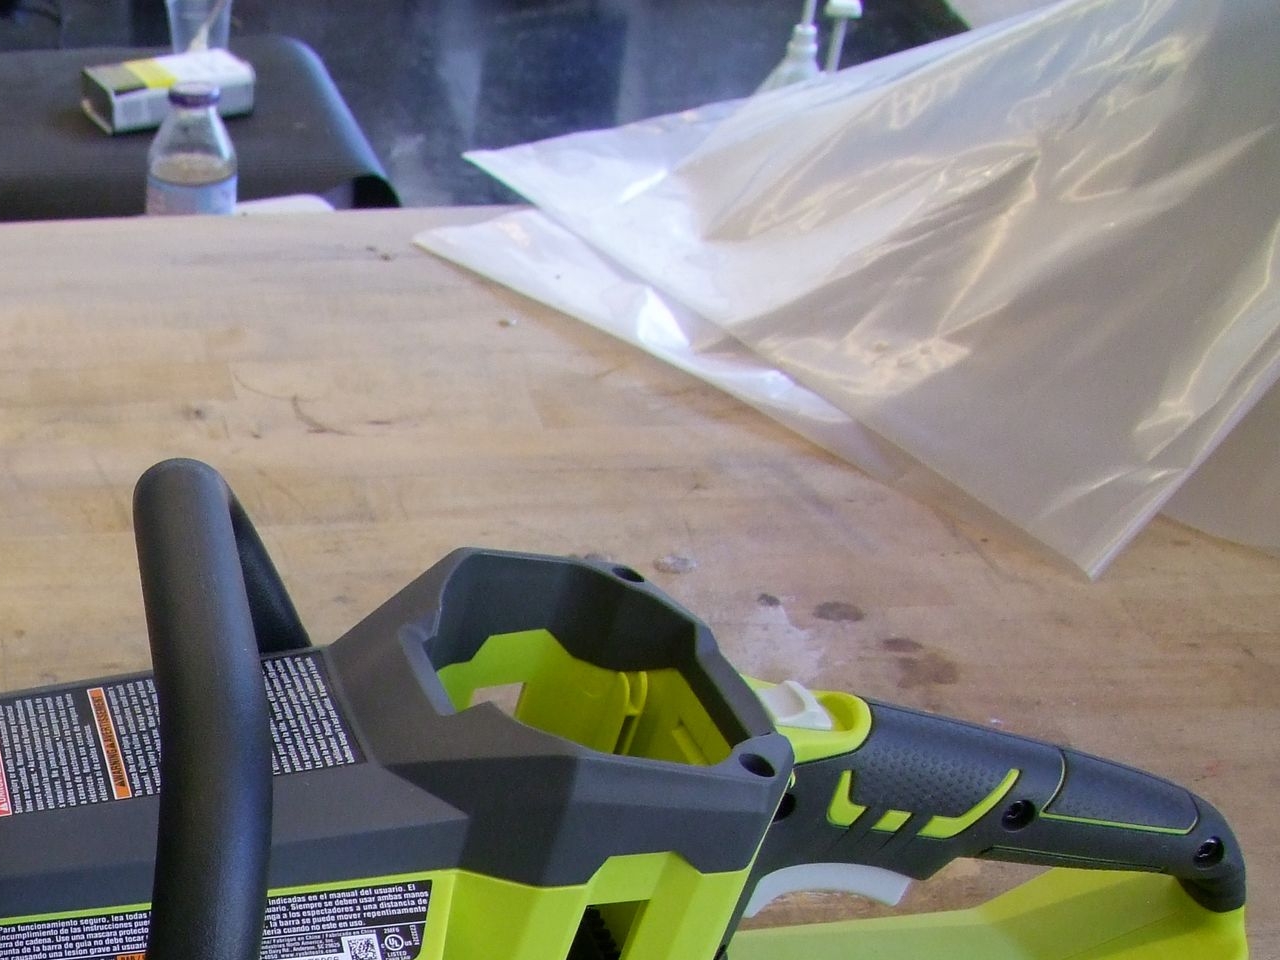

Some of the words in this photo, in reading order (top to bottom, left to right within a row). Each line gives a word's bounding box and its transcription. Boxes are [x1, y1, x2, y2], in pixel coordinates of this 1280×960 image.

[106, 748, 123, 782] WARNING
[17, 919, 78, 932] funcionamiento
[111, 913, 123, 921] lea
[125, 911, 147, 920] todas
[268, 895, 306, 904] indicadas
[328, 890, 358, 899] manual
[373, 885, 405, 894] usuario.
[24, 937, 53, 945] cadena.
[55, 934, 69, 942] Use
[86, 930, 117, 939] mascara
[118, 927, 148, 936] protecto
[301, 905, 353, 917] espectadores
[379, 899, 415, 908] distancia
[41, 943, 62, 951] barra
[63, 941, 73, 949] de
[93, 938, 103, 946] no
[104, 936, 123, 944] debe
[124, 934, 143, 942] tocar
[278, 918, 299, 926] barra
[312, 915, 335, 924] puede
[336, 912, 360, 920] mover
[363, 905, 426, 918] repentinamente
[82, 921, 132, 932] instrucciones
[133, 919, 150, 927] pue
[290, 901, 322, 910] Siempre
[334, 898, 357, 906] deben
[376, 893, 402, 902] ambas
[403, 891, 428, 899] manos
[48, 950, 62, 958] una
[89, 946, 110, 954] grave
[282, 924, 309, 933] cuando
[348, 919, 365, 927] uso.
